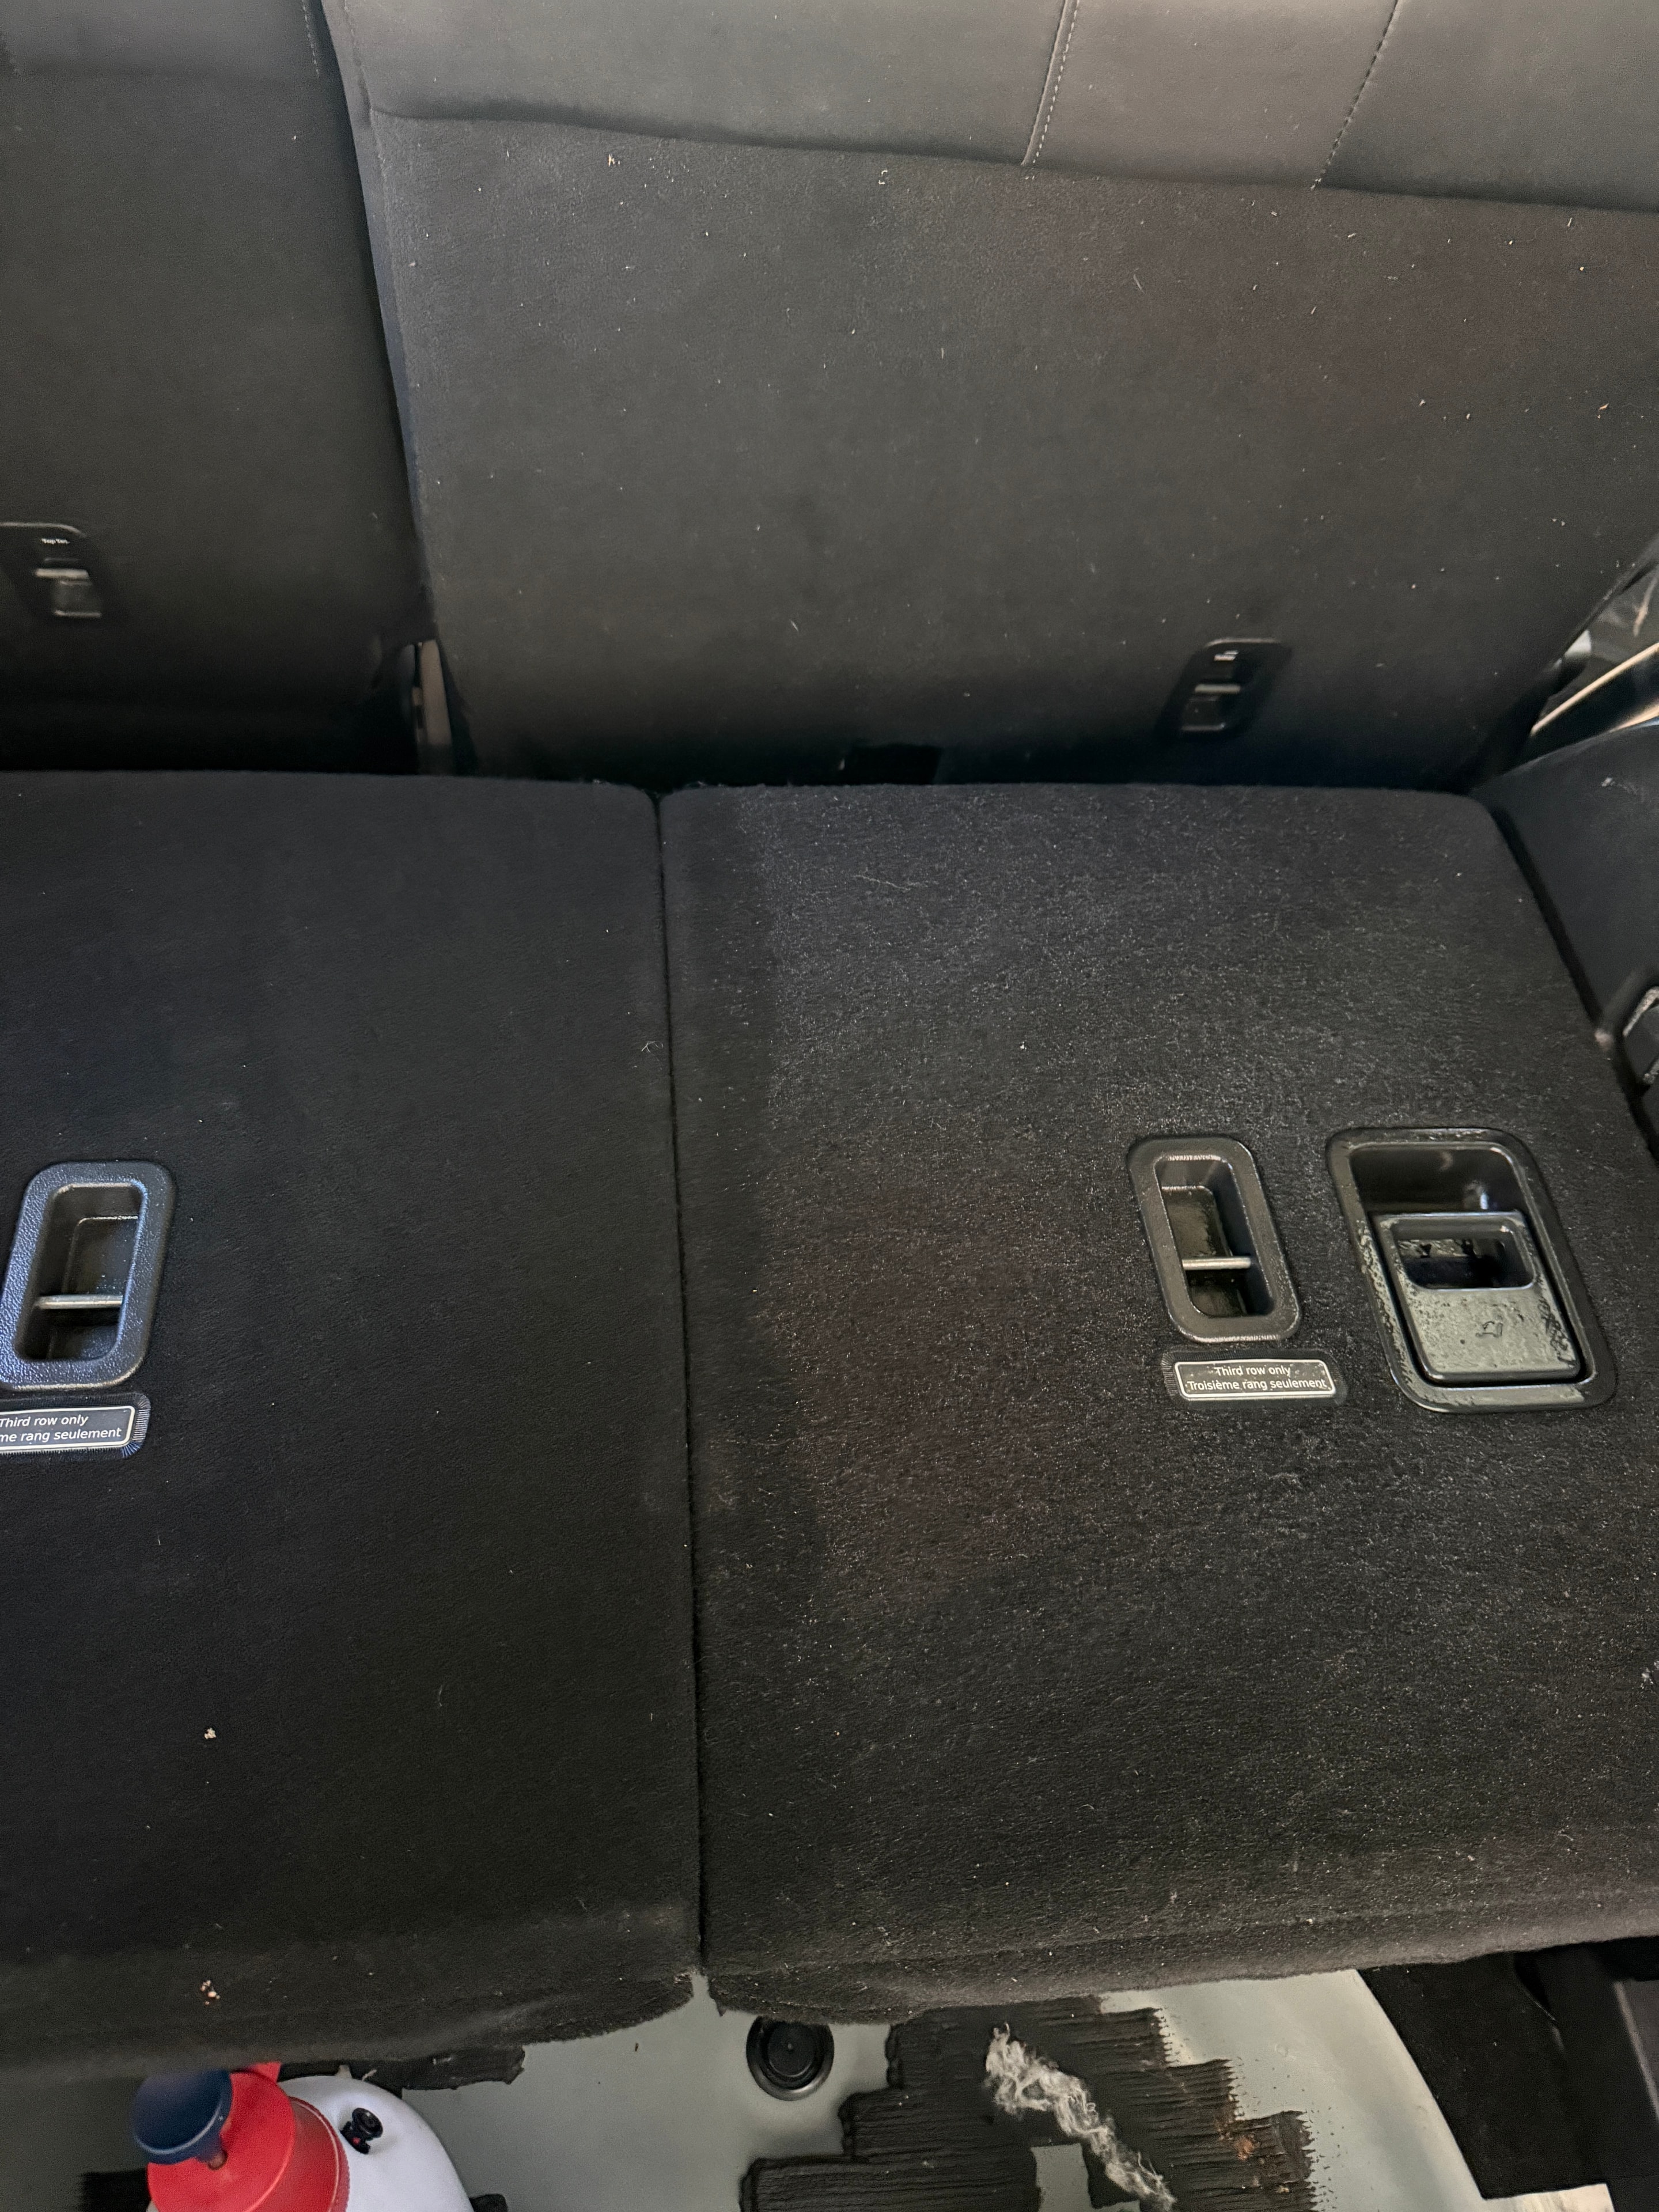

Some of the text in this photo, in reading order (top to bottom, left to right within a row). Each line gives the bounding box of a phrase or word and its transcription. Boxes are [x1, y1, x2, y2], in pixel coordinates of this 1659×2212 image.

[1214, 1365, 1290, 1376] Third row only
[1187, 1378, 1327, 1391] Troisième rang seulement
[0, 1414, 89, 1427] Third row only
[21, 1431, 50, 1442] rang
[54, 1427, 122, 1440] seulement
